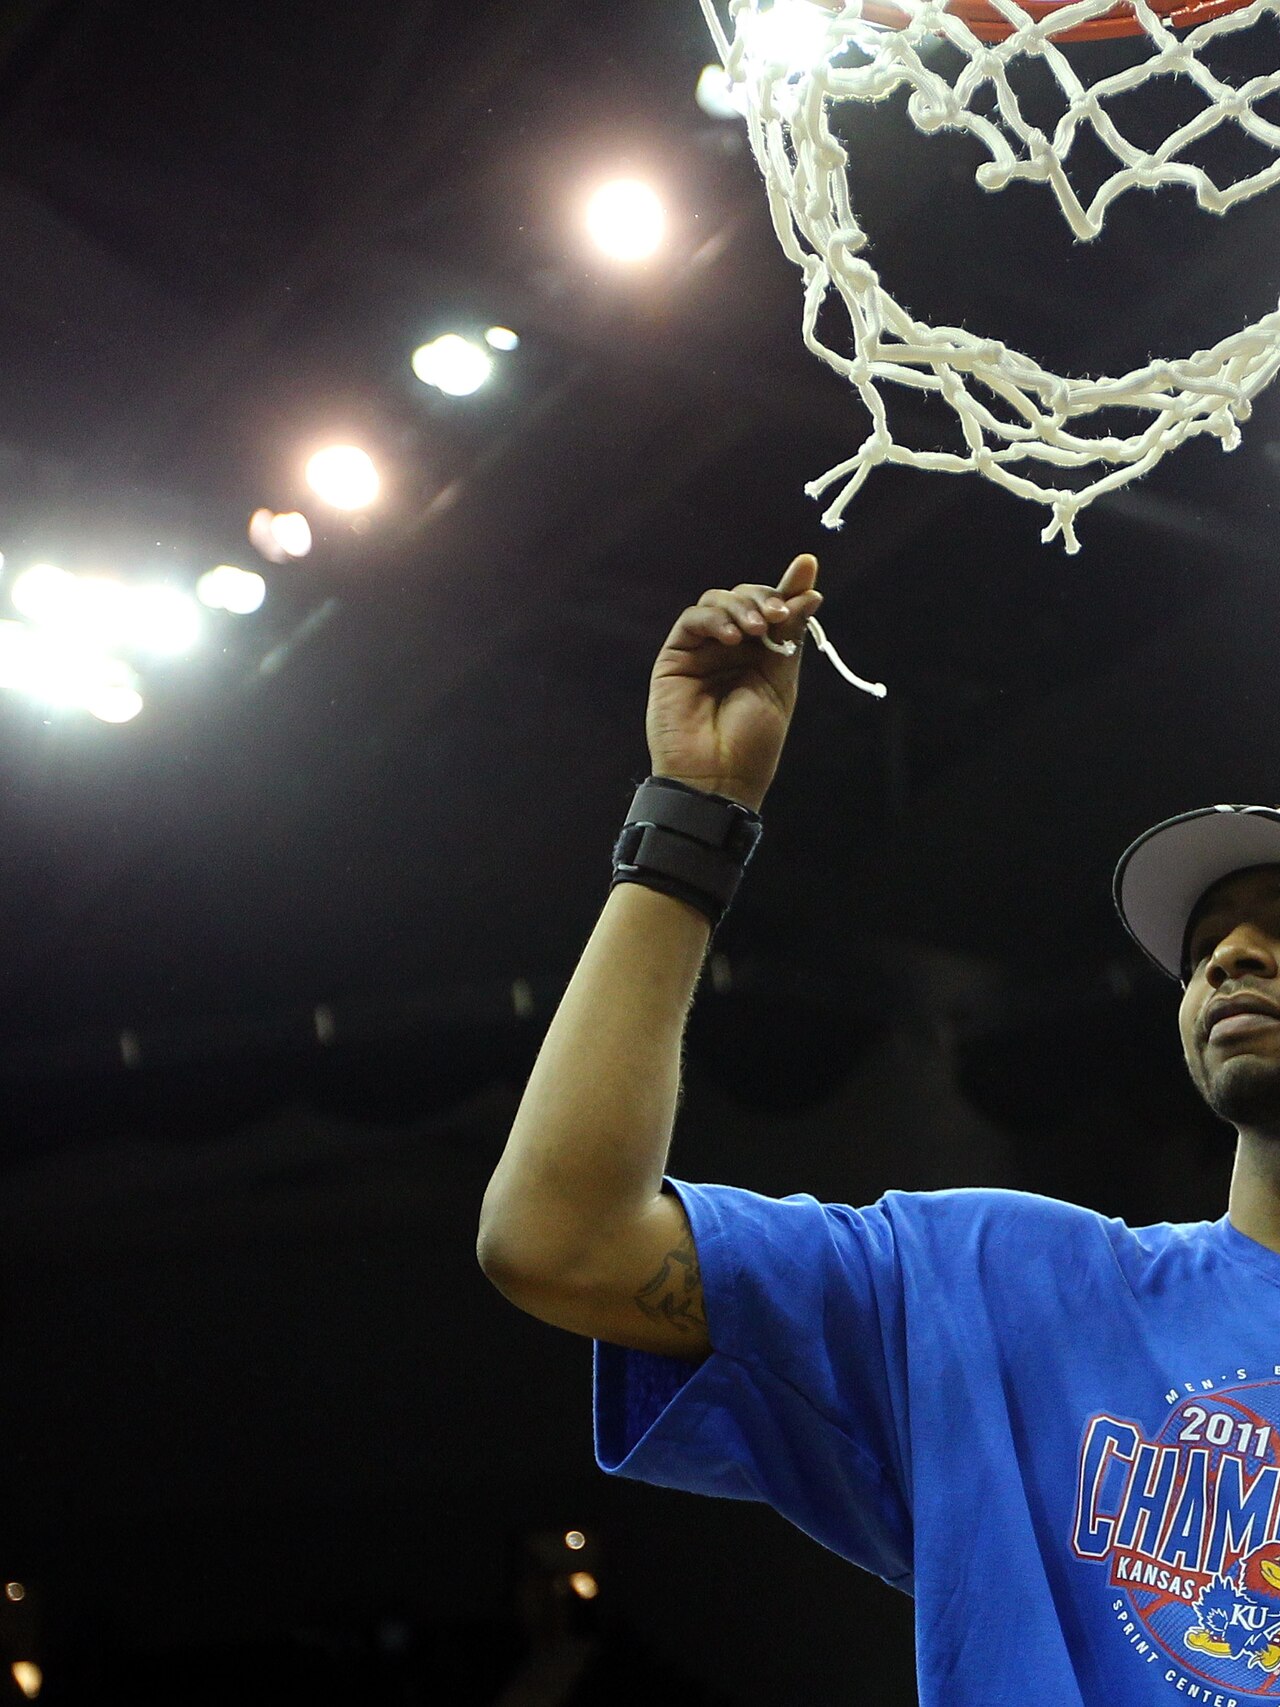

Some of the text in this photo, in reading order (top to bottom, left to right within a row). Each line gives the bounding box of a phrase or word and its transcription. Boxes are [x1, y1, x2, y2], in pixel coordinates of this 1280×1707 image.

[1164, 1367, 1247, 1405] MEN'S
[1179, 1407, 1272, 1458] 2011
[1116, 1556, 1196, 1600] KANSAS
[1229, 1603, 1269, 1631] KU
[1112, 1599, 1238, 1707] SPRINT CENTER
